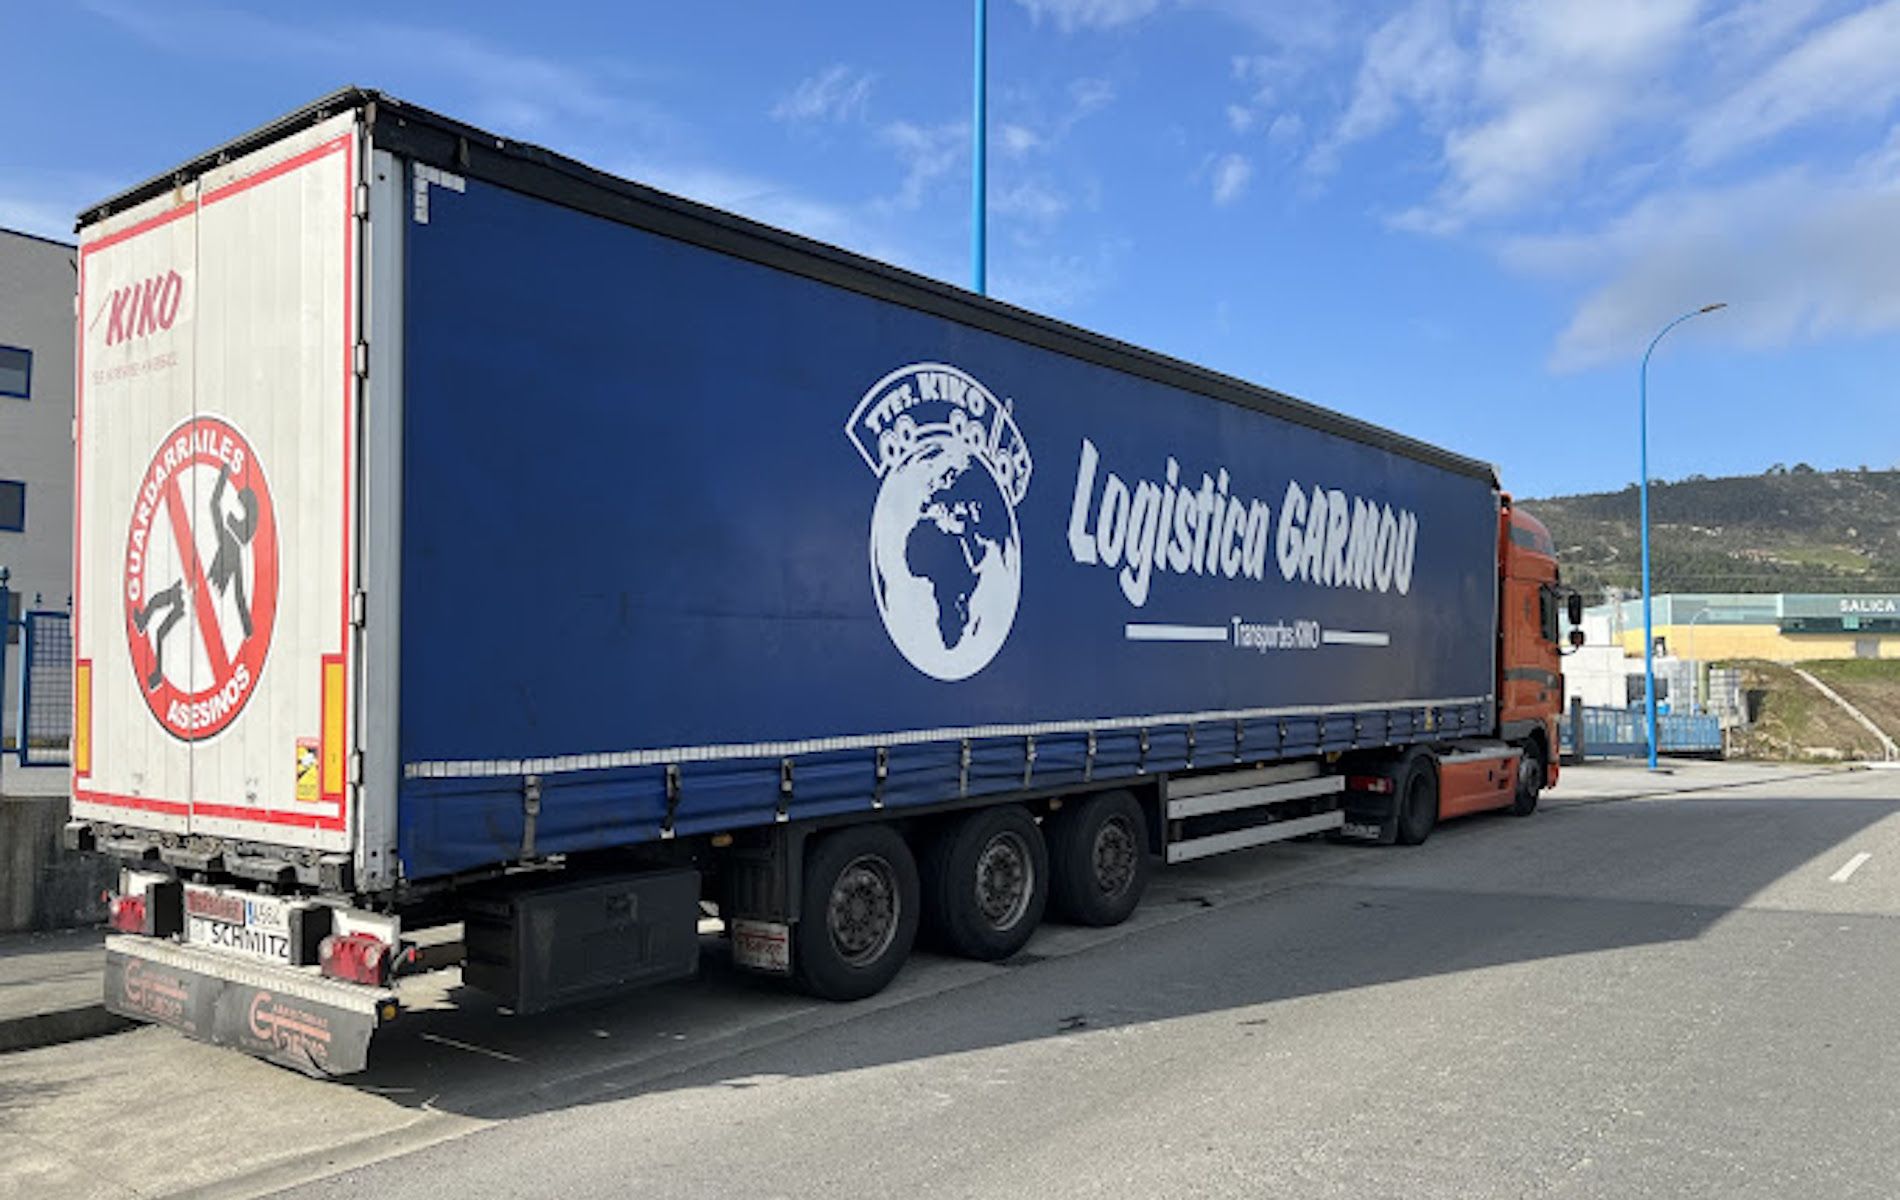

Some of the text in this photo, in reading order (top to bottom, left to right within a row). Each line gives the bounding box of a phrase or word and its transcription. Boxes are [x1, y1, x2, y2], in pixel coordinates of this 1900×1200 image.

[105, 269, 183, 346] KIKO
[915, 372, 986, 417] KIKO
[127, 428, 245, 601] GUARDARRAILES
[1067, 437, 1419, 607] Logistica GARMOU
[1839, 598, 1897, 613] SALICA
[1230, 615, 1293, 655] Transportes
[166, 662, 251, 730] ASESINOS
[211, 922, 290, 958] SCHMITZ
